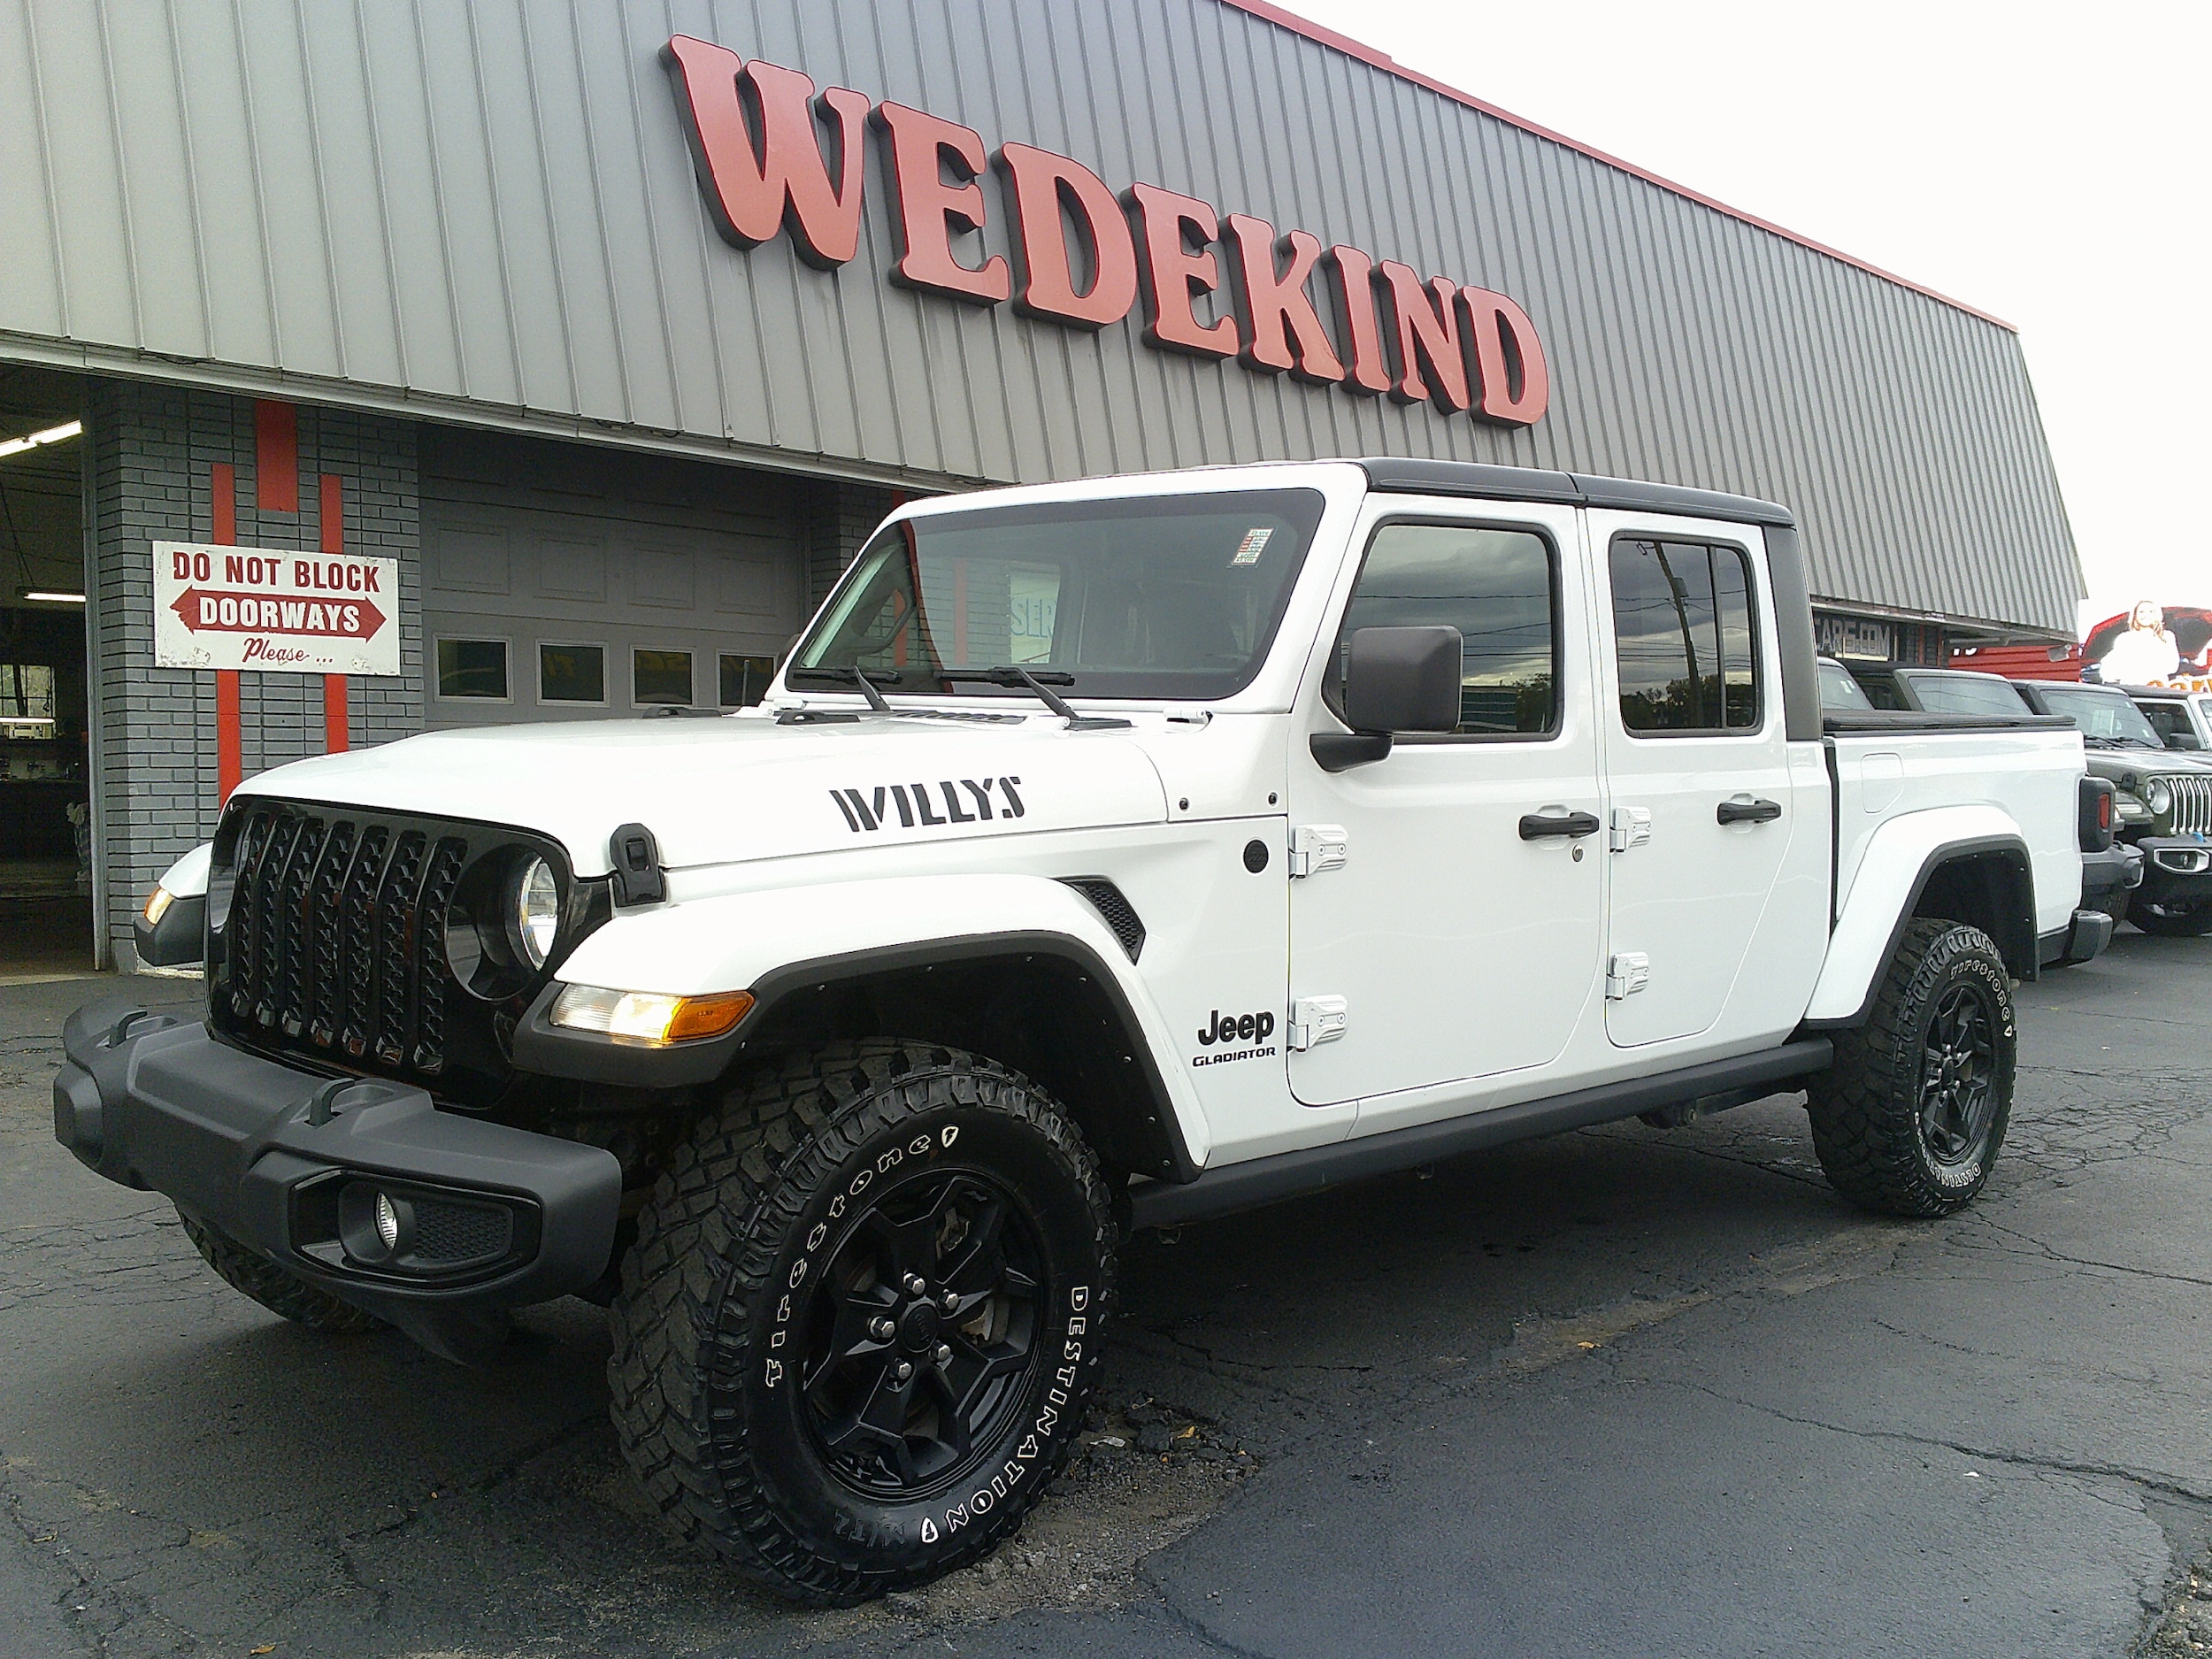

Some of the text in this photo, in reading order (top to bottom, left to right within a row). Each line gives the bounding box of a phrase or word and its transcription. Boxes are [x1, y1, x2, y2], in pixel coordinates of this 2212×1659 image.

[661, 35, 1550, 429] WEDEKIND
[173, 551, 380, 593] DO NOT BLOCK
[200, 596, 361, 633] DOORWAYS
[242, 637, 310, 663] Please
[828, 776, 1025, 832] WILLYS
[1198, 1010, 1274, 1045] Jeep
[1193, 1047, 1276, 1067] GLADIATOR
[944, 1286, 1089, 1533] DESTINATION
